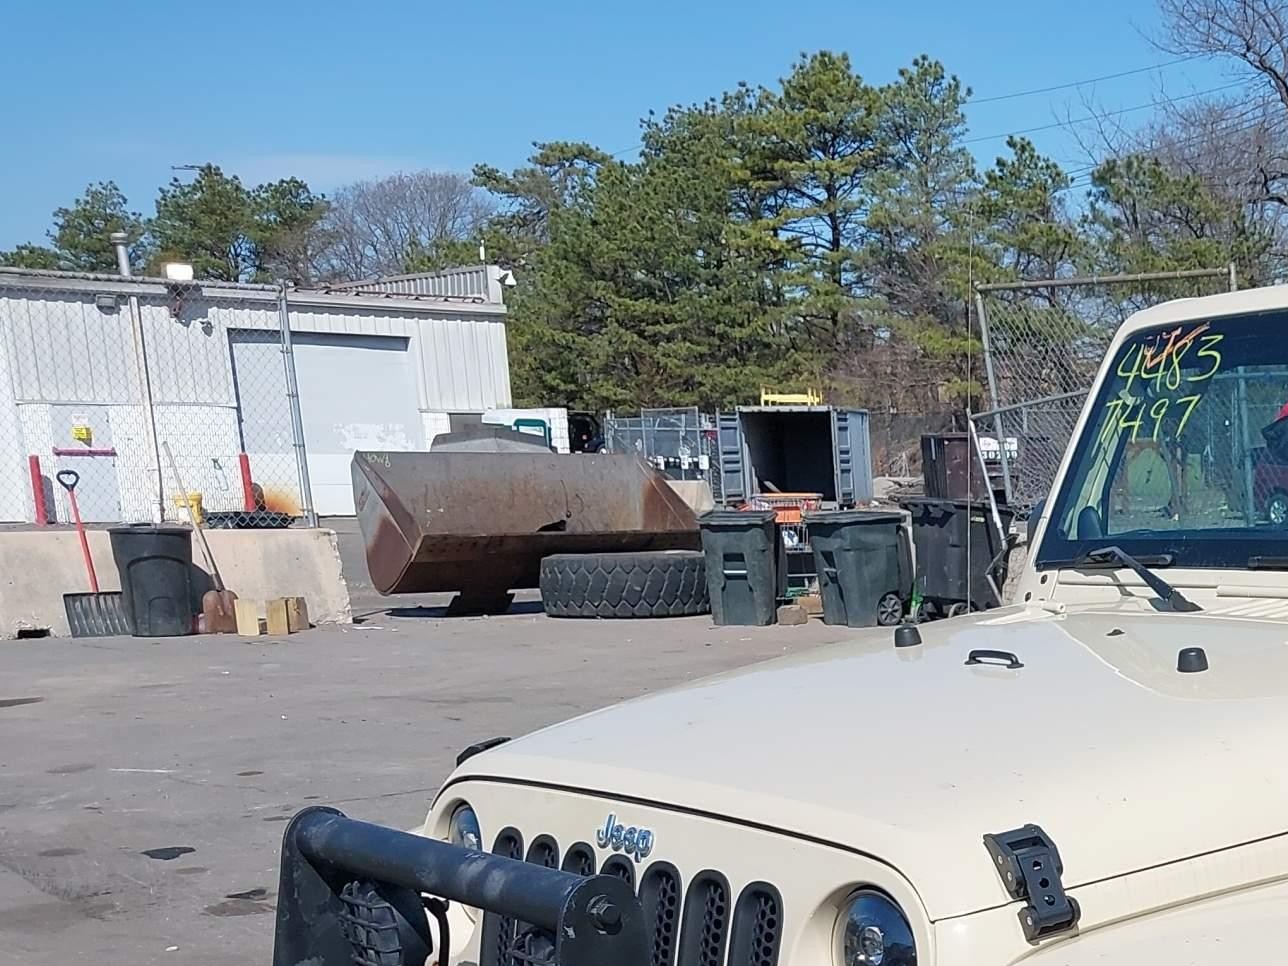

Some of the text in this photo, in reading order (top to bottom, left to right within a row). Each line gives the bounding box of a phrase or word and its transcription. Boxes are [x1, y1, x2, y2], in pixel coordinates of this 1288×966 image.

[1117, 335, 1224, 392] 4483
[1102, 395, 1201, 443] 7497
[597, 814, 654, 863] Jeep
